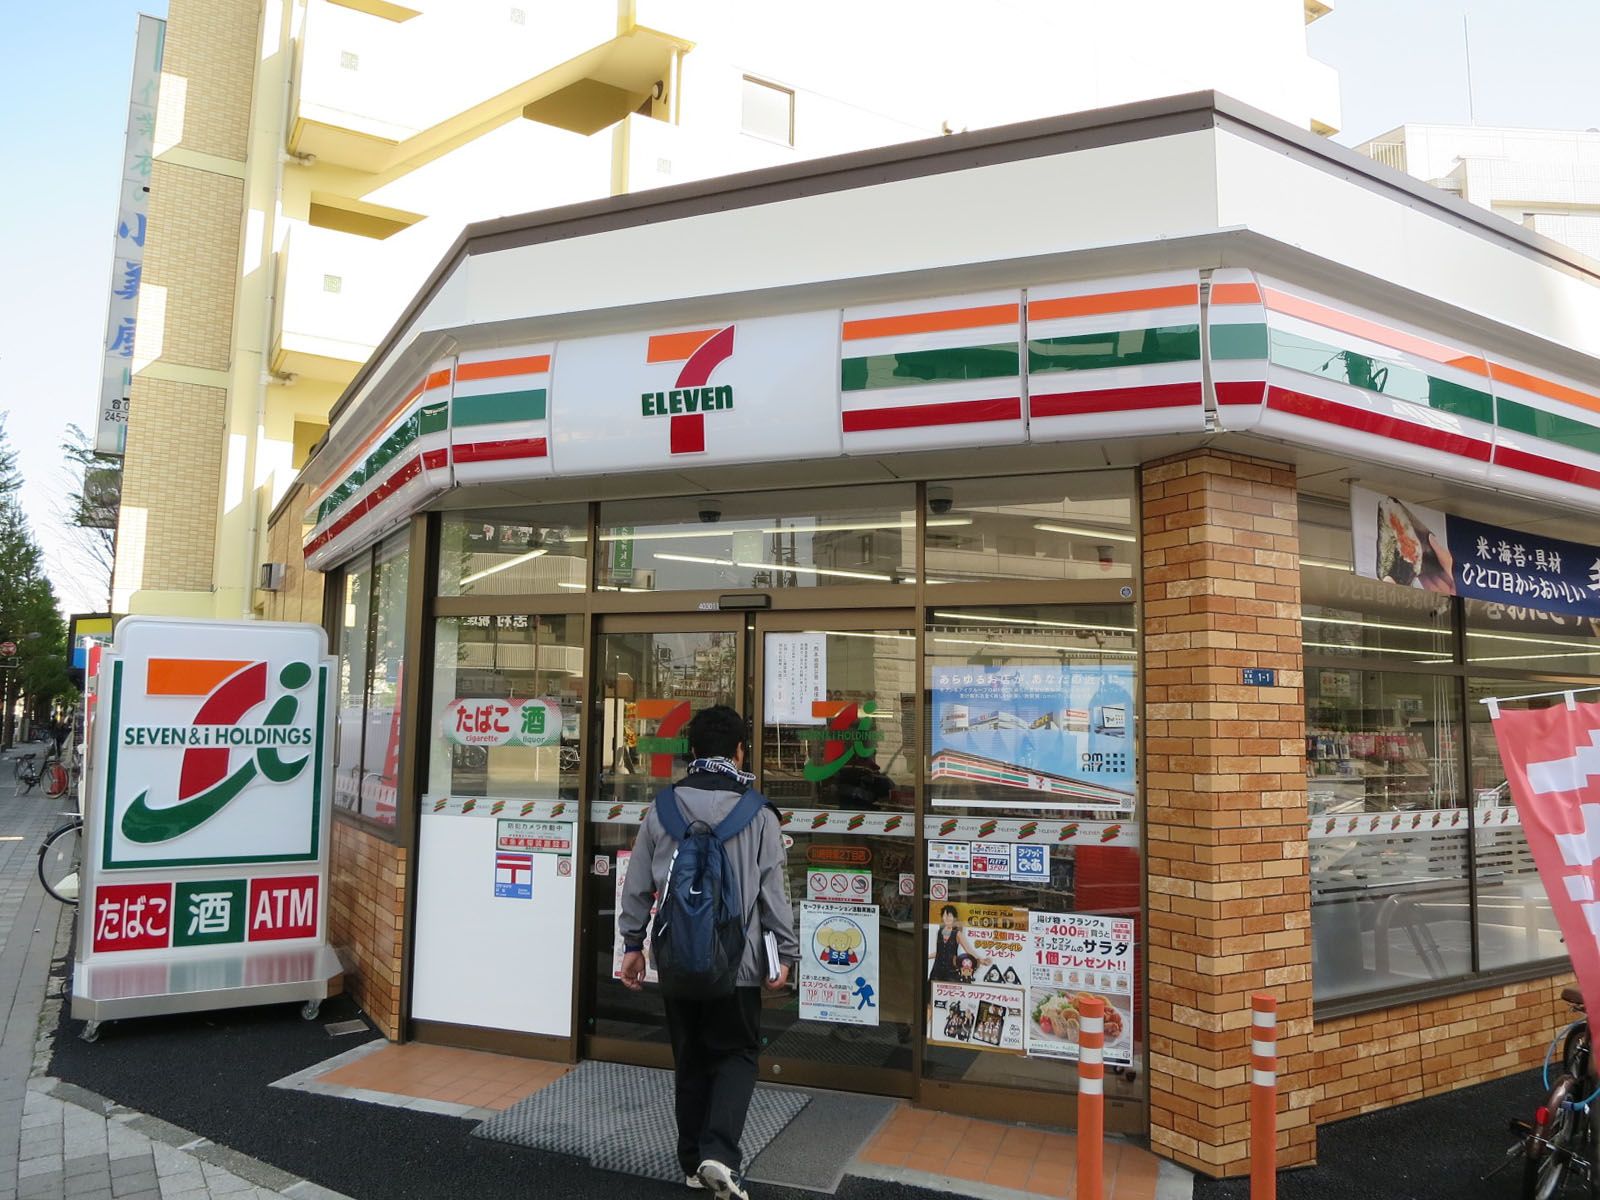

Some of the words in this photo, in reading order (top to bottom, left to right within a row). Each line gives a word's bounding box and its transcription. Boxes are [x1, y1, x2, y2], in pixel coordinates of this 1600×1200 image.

[1476, 536, 1562, 574] 米・海苔・具材
[1462, 562, 1587, 603] ひと口目からおいしい
[456, 704, 510, 733] たばこ
[520, 705, 546, 734] 酒
[215, 727, 312, 745] HOLDINGS
[465, 734, 499, 743] cigarette
[522, 735, 546, 743] liquor
[1018, 848, 1042, 858] チケット
[1018, 858, 1042, 872] ぴあ
[96, 896, 168, 941] たばこ
[187, 891, 233, 936] 酒
[253, 888, 313, 930] ATM
[968, 916, 1015, 929] GOLD
[985, 949, 1016, 958] プレゼント
